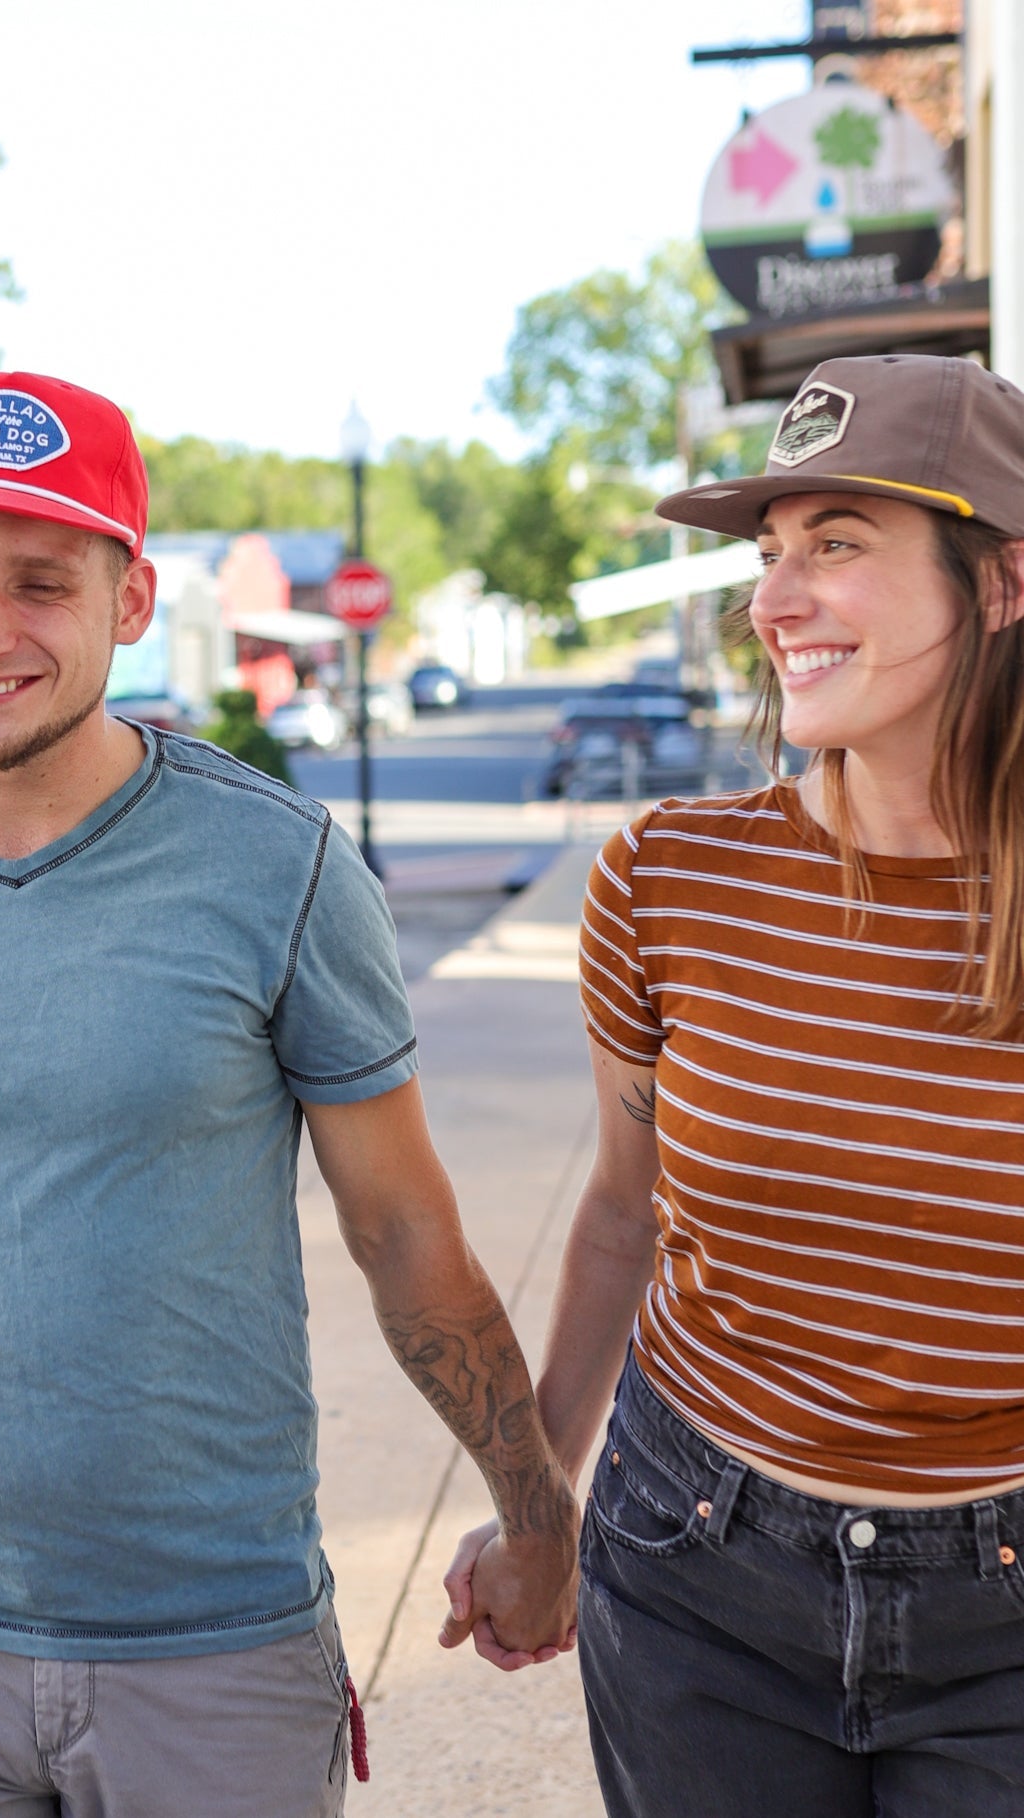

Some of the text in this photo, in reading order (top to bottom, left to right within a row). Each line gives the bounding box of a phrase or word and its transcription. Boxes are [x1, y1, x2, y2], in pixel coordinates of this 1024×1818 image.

[6, 414, 23, 427] the
[7, 428, 49, 447] DOG
[23, 445, 35, 454] ST
[15, 454, 27, 463] TX
